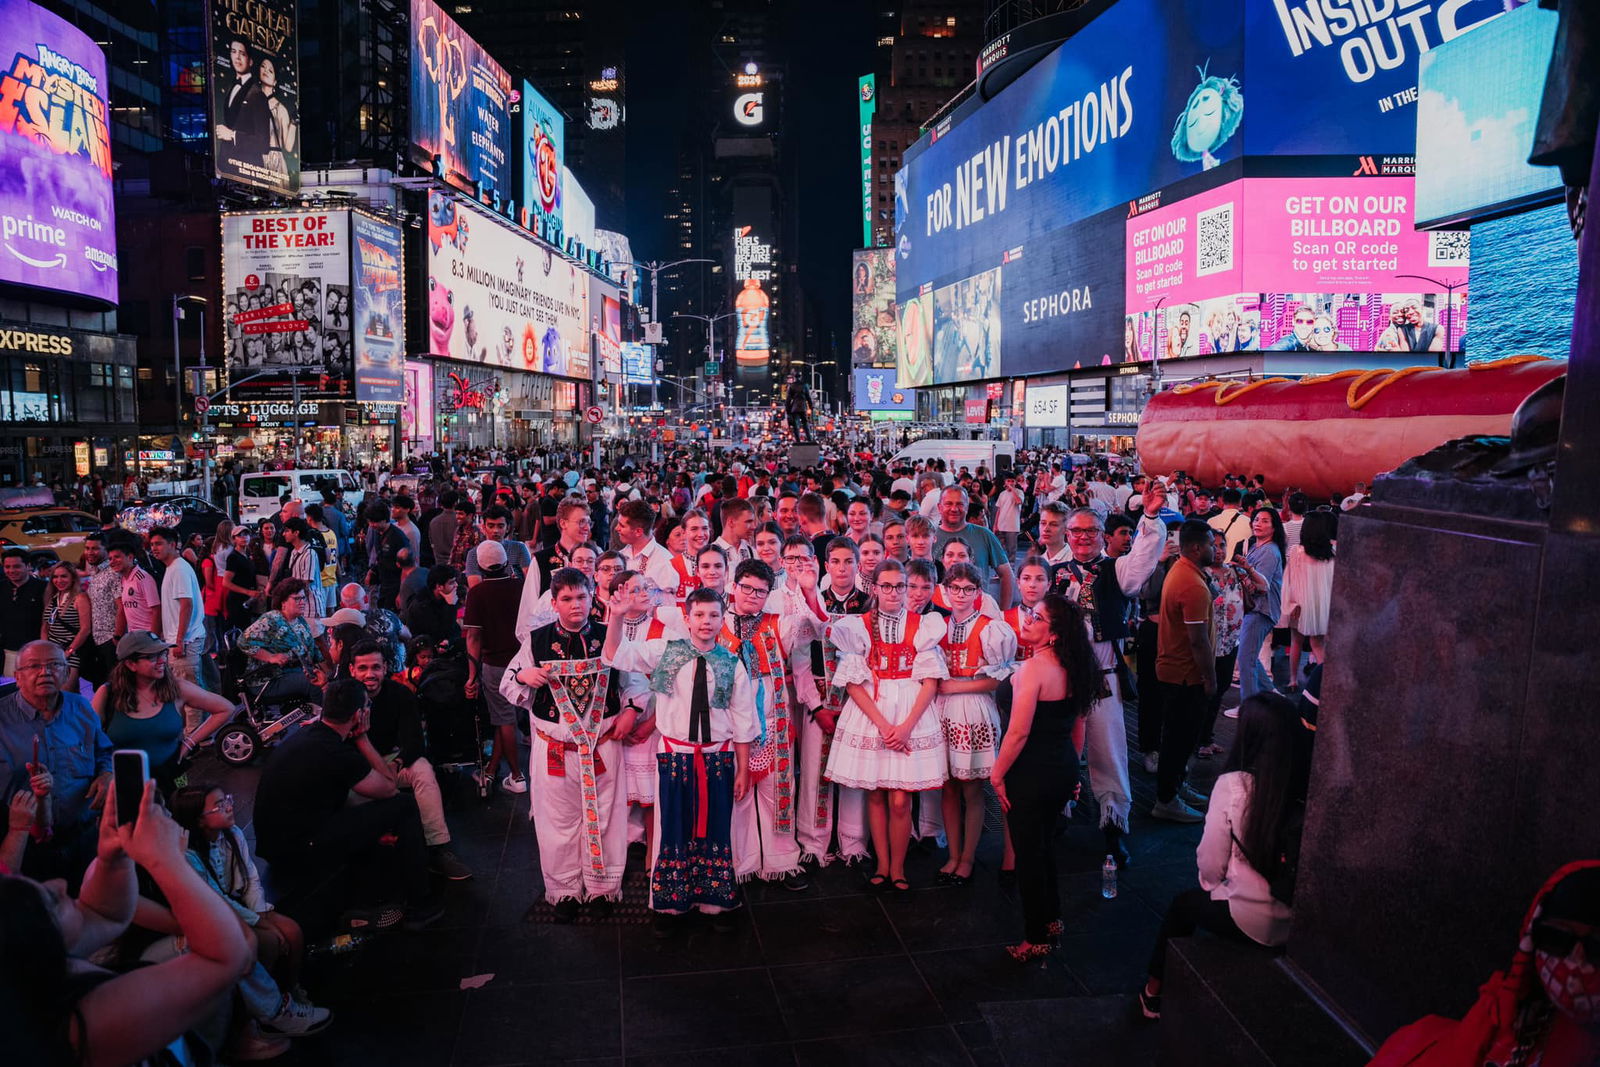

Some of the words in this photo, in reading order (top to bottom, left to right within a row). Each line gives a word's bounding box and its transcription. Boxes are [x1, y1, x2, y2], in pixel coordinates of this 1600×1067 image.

[226, 12, 285, 52] GATSBY
[982, 34, 1010, 59] MARRIOTT
[1340, 5, 1432, 83] OUT
[38, 45, 74, 79] ANGRY
[75, 65, 97, 94] BIRDS
[982, 47, 1007, 69] MARQUIS
[13, 56, 104, 121] MYSTERY
[1378, 97, 1394, 112] IN
[1394, 87, 1418, 107] THE
[477, 105, 500, 134] WATER
[734, 92, 764, 125] G
[0, 75, 112, 181] ISLAND
[862, 124, 872, 149] 50
[472, 131, 504, 165] ELEPHANTS
[927, 182, 952, 236] FOR
[956, 135, 1010, 230] NEW
[1015, 66, 1133, 190] EMOTIONS
[864, 156, 872, 222] YEARS
[1139, 192, 1162, 204] MARRIOTT
[1139, 200, 1160, 213] MARQUIS
[1286, 196, 1324, 214] GET
[1329, 196, 1358, 214] ON
[1364, 196, 1406, 214] OUR
[52, 205, 90, 228] WATCH
[90, 218, 102, 232] ON
[252, 216, 300, 233] BEST
[303, 216, 327, 231] OF
[1291, 219, 1401, 236] BILLBOARD
[2, 214, 66, 247] prime
[243, 234, 279, 249] THE
[283, 232, 335, 248] YEAR!
[735, 236, 760, 246] FUELS
[1133, 228, 1150, 248] GET
[1151, 223, 1165, 242] ON
[1166, 217, 1187, 238] OUR
[735, 254, 770, 263] BECAUSE
[736, 245, 750, 254] THE
[751, 245, 770, 254] BEST
[1136, 238, 1184, 266] BILLBOARD
[1293, 241, 1329, 254] Scan
[1334, 241, 1356, 254] QR
[1362, 240, 1398, 254] code
[736, 271, 750, 280] THE
[751, 271, 770, 280] BEST
[743, 263, 752, 272] IS
[1136, 268, 1152, 281] Scan
[1154, 263, 1164, 276] QR
[1166, 260, 1182, 272] code
[1292, 258, 1308, 270] to
[1312, 258, 1338, 273] get
[1342, 257, 1398, 270] started
[452, 259, 464, 278] 8.3
[466, 264, 496, 290] MILLION
[497, 278, 532, 302] IMAGINARY
[533, 290, 554, 312] FRIENDS
[554, 300, 564, 316] LIVE
[564, 303, 570, 318] IN
[1136, 283, 1144, 294] to
[1145, 280, 1156, 294] get
[1157, 272, 1183, 290] started
[235, 309, 274, 322] MERRILY
[280, 303, 291, 312] WE
[505, 298, 518, 316] JUST
[536, 309, 544, 324] SEE
[1023, 286, 1092, 324] SEPHORA
[276, 322, 305, 331] ALONG
[0, 331, 73, 355] XPRESS
[250, 404, 319, 416] LUGGAGE
[1034, 400, 1046, 414] 654
[1050, 400, 1058, 414] SF
[280, 711, 302, 726] RIDER
